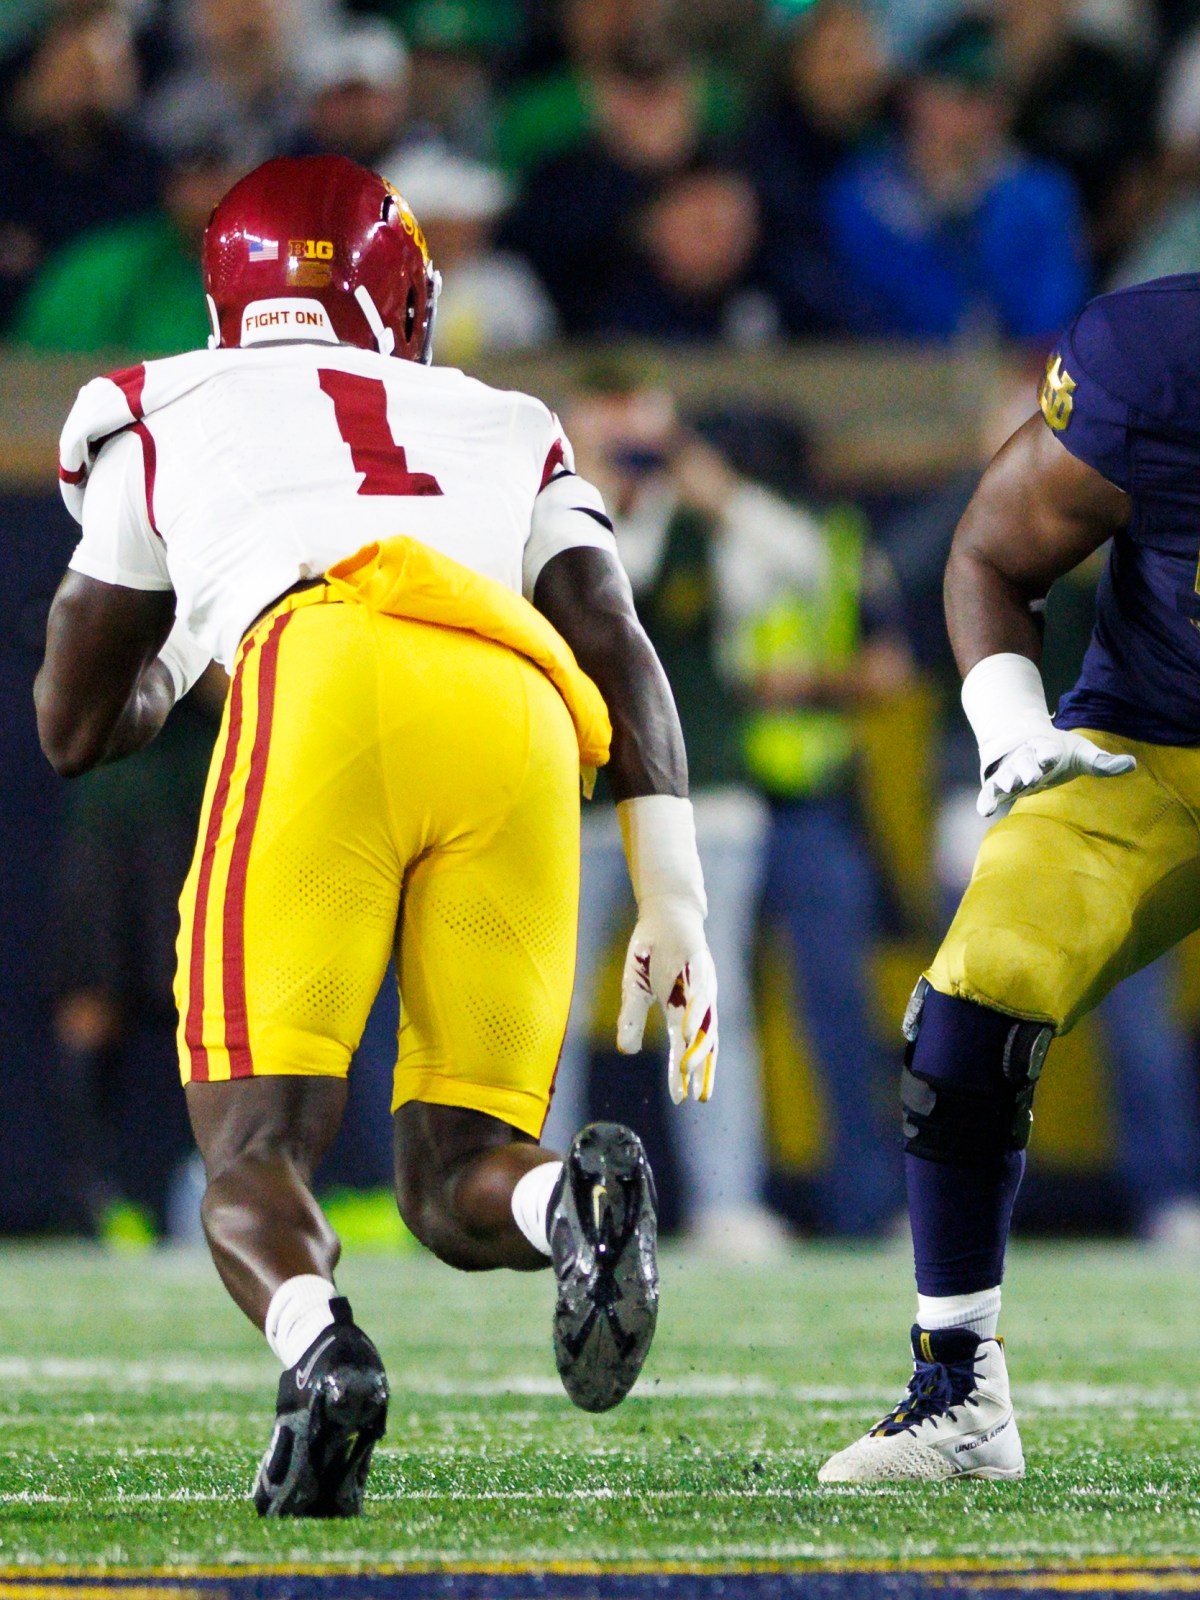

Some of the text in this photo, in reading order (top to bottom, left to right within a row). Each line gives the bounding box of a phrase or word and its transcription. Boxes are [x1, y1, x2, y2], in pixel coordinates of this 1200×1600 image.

[245, 310, 324, 331] FIGHT ON!
[318, 368, 444, 496] 1
